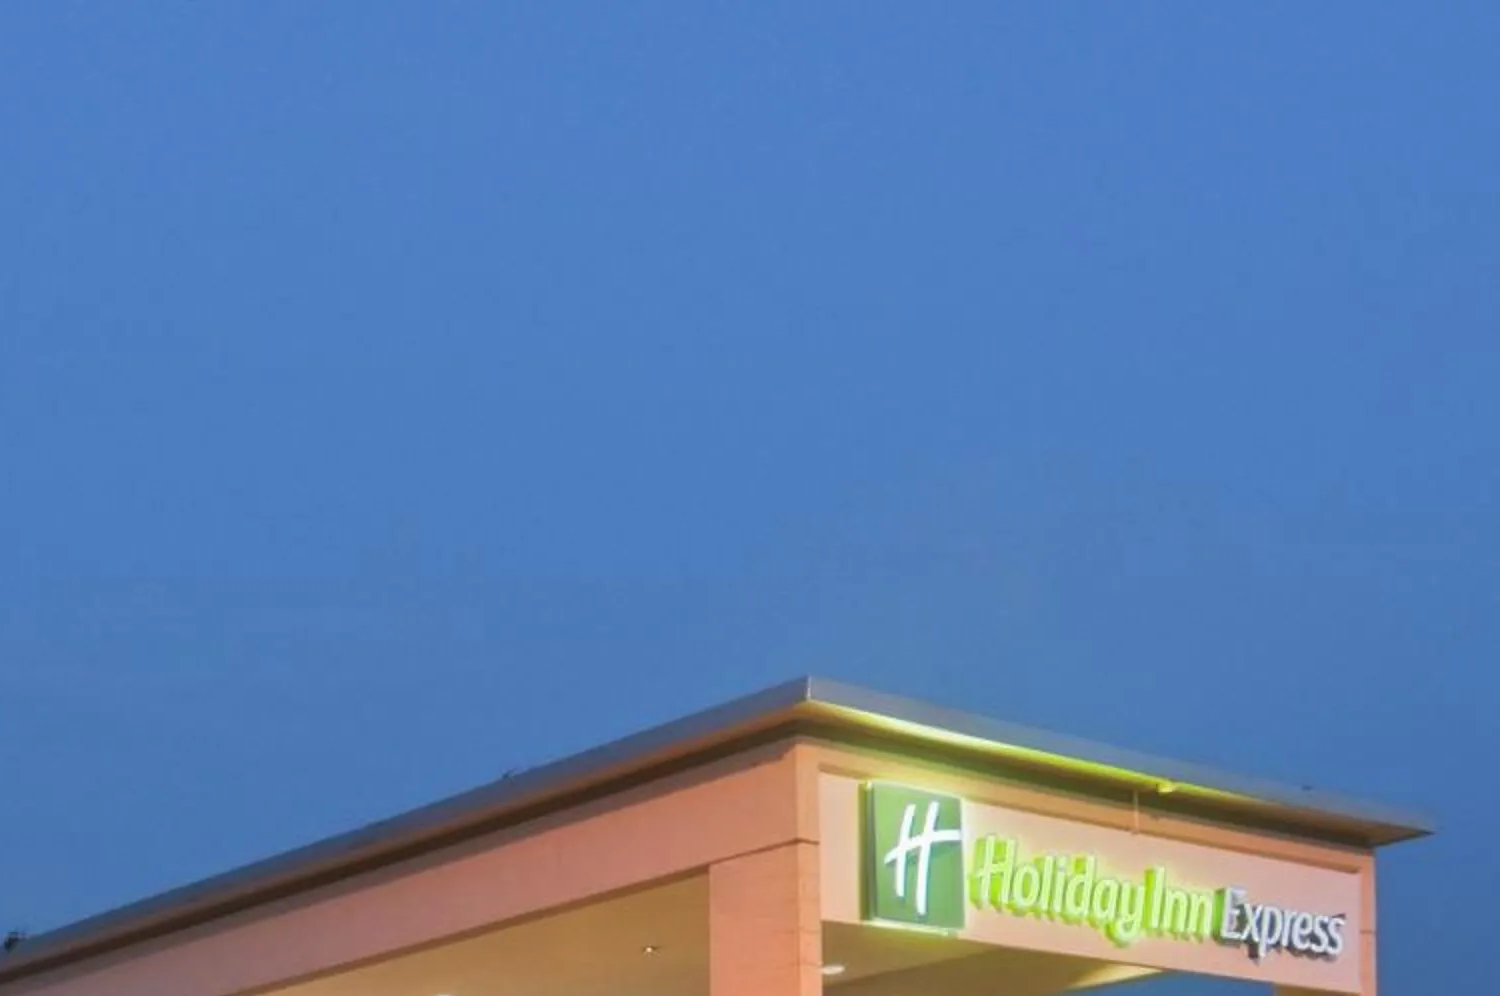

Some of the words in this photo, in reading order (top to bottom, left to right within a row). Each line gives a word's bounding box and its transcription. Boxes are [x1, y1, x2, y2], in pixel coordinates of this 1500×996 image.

[970, 835, 1144, 946] Holiday
[1145, 866, 1212, 942] Inn
[1218, 886, 1346, 964] Express
